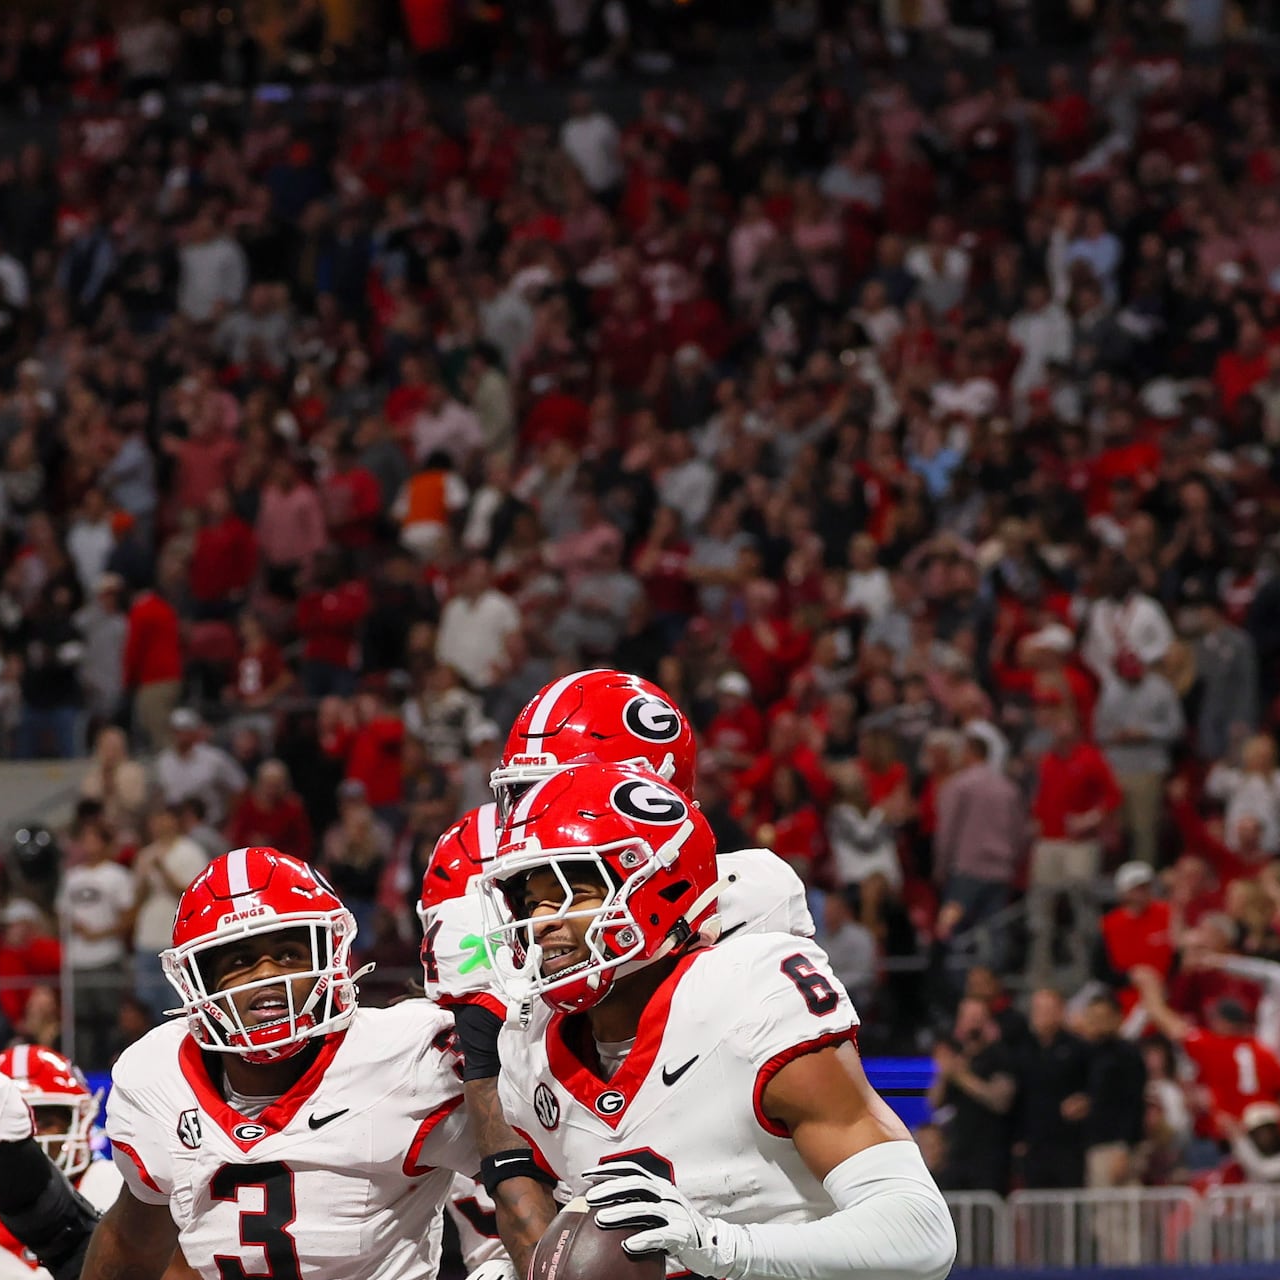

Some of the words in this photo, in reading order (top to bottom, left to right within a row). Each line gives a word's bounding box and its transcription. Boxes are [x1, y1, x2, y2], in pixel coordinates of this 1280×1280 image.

[613, 782, 687, 822] G
[224, 907, 266, 925] DAWGS
[780, 952, 839, 1017] 6
[598, 1093, 625, 1114] G
[180, 1111, 201, 1147] SE
[235, 1124, 265, 1140] G
